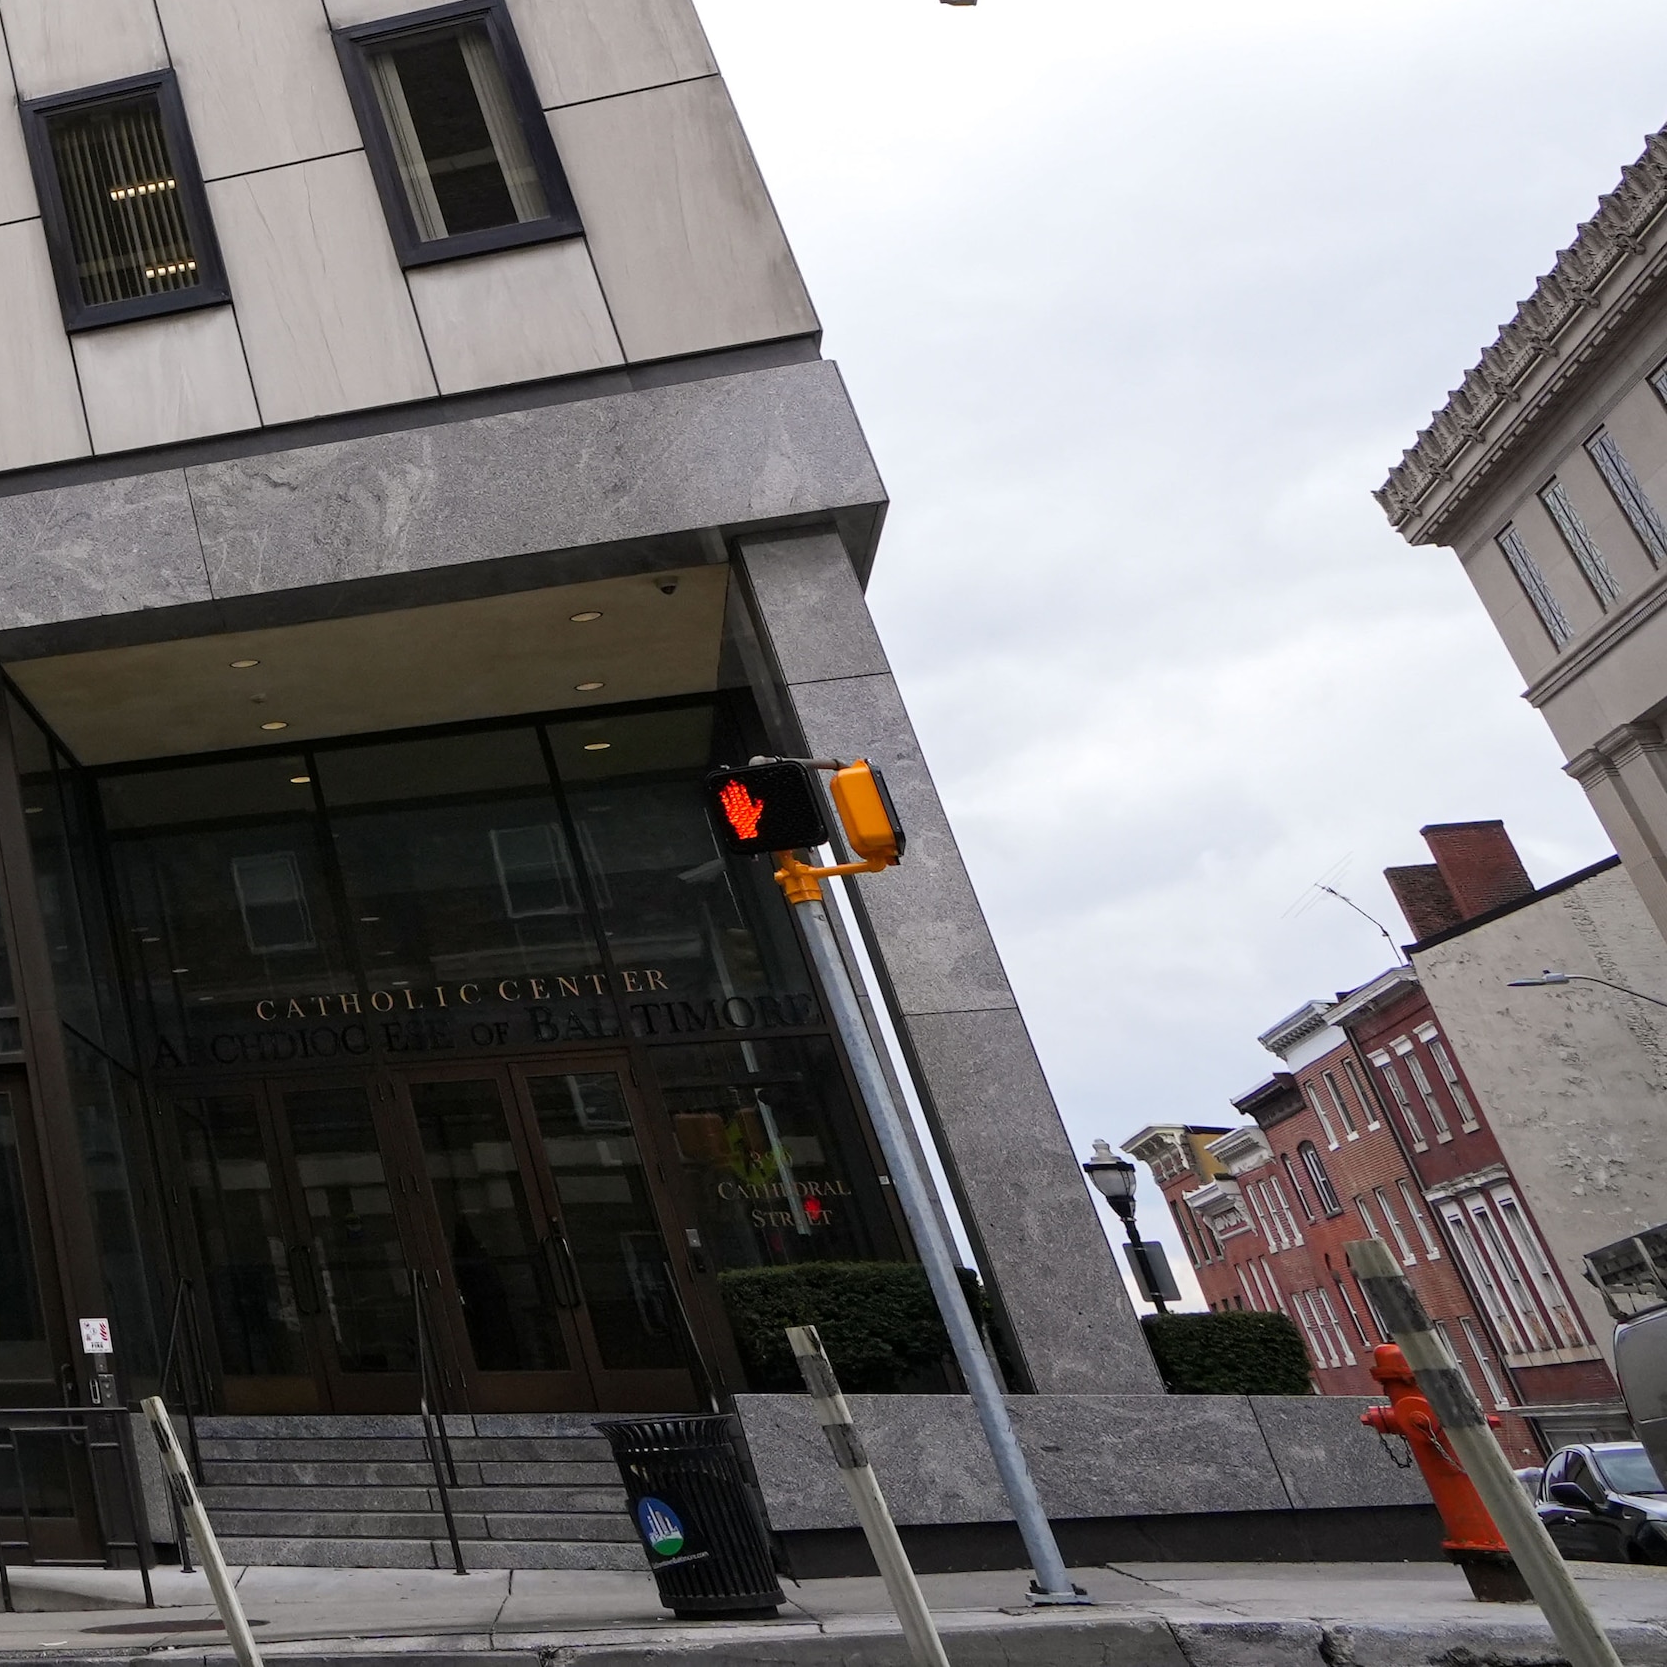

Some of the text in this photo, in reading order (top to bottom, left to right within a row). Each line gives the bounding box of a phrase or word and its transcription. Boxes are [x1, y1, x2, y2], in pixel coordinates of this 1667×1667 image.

[257, 969, 669, 1021] CATHOLIC CENTER
[154, 994, 818, 1070] ARCHDIOCESE OF BALTIMORE
[750, 1148, 793, 1170] 30
[718, 1180, 852, 1201] CATHDRAL
[752, 1208, 833, 1228] STRET
